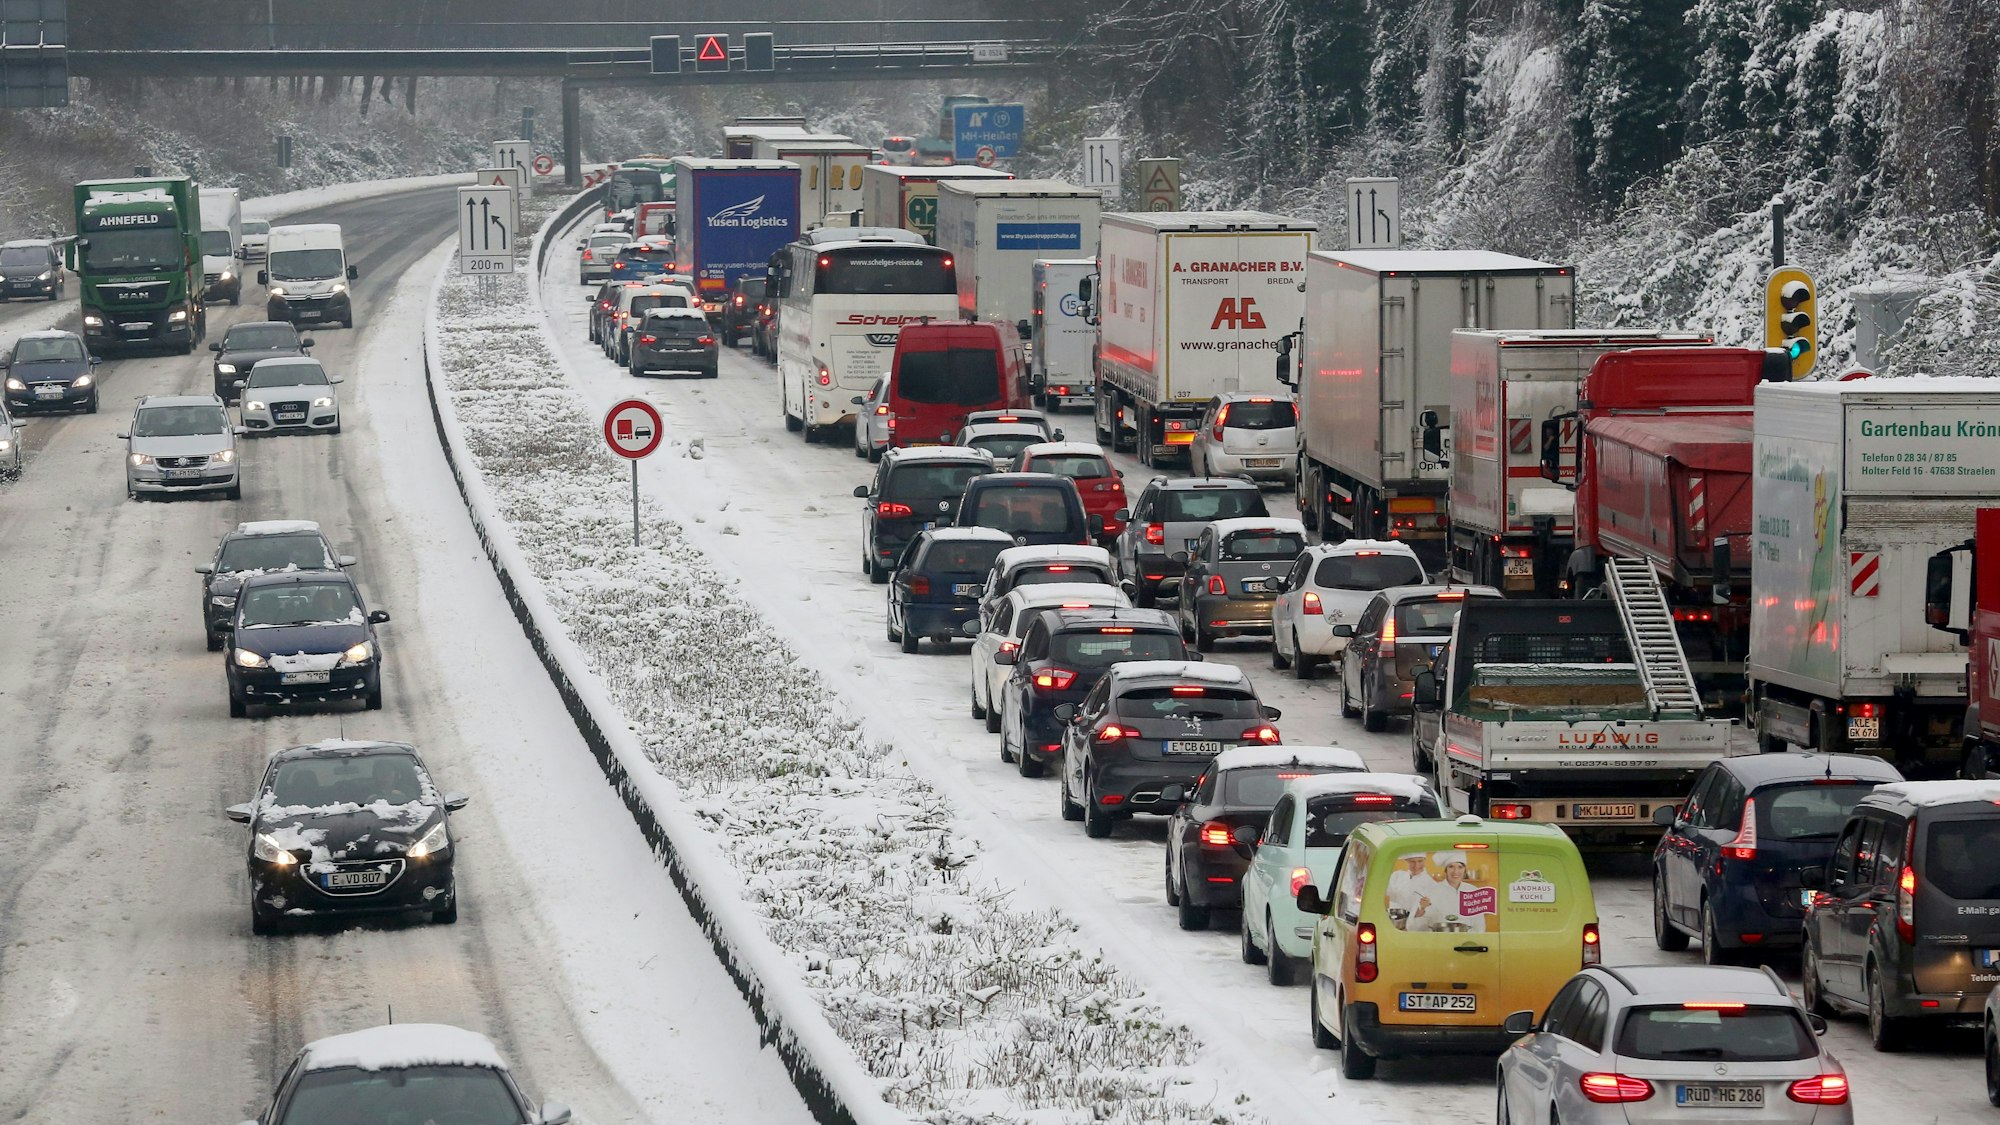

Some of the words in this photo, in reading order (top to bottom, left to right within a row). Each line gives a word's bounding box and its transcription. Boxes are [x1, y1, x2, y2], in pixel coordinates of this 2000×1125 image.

[997, 114, 1007, 123] 19
[99, 214, 159, 227] AHNEFELD
[707, 216, 738, 226] Yusen
[741, 216, 788, 229] Logistics
[470, 260, 490, 270] 200
[494, 262, 504, 270] m
[850, 258, 924, 267] www.schelges-reisen.de
[1173, 262, 1186, 272] A.
[1190, 262, 1276, 272] GRANACHER
[1280, 262, 1304, 272] B.V.
[1066, 300, 1076, 310] 15
[1862, 420, 1951, 437] Gartenbau
[1957, 420, 2000, 437] Krön
[1862, 453, 1894, 462] Telefon
[1896, 454, 1902, 462] 0
[1904, 454, 1914, 462] 28
[1916, 454, 1926, 462] 34
[1934, 454, 1944, 462] 87
[1946, 454, 1957, 462] 85
[1862, 466, 1890, 476] Holter
[1892, 466, 1910, 476] Feld
[1913, 466, 1923, 475] 16
[1930, 466, 1955, 476] 47638
[1958, 466, 1996, 476] Straelen
[1508, 566, 1518, 574] WG
[1520, 566, 1528, 574] 54
[956, 584, 966, 592] DU
[1854, 718, 1870, 728] KLE
[1850, 728, 1860, 737] GK
[1862, 728, 1878, 737] 678
[1559, 733, 1659, 744] LUDWIG
[1172, 742, 1178, 752] E
[1184, 742, 1198, 752] CB
[1200, 742, 1218, 752] 610
[1579, 806, 1592, 816] MK
[1599, 806, 1612, 816] LU
[1614, 806, 1634, 816] 110
[332, 875, 340, 884] E
[346, 874, 360, 884] VD
[362, 872, 380, 883] 807
[1958, 906, 1988, 914] E-Mail:
[1408, 995, 1424, 1008] ST
[1432, 996, 1448, 1008] AP
[1451, 996, 1474, 1009] 252
[1686, 1088, 1710, 1102] RÜD
[1719, 1088, 1736, 1102] HG
[1738, 1088, 1762, 1102] 286
